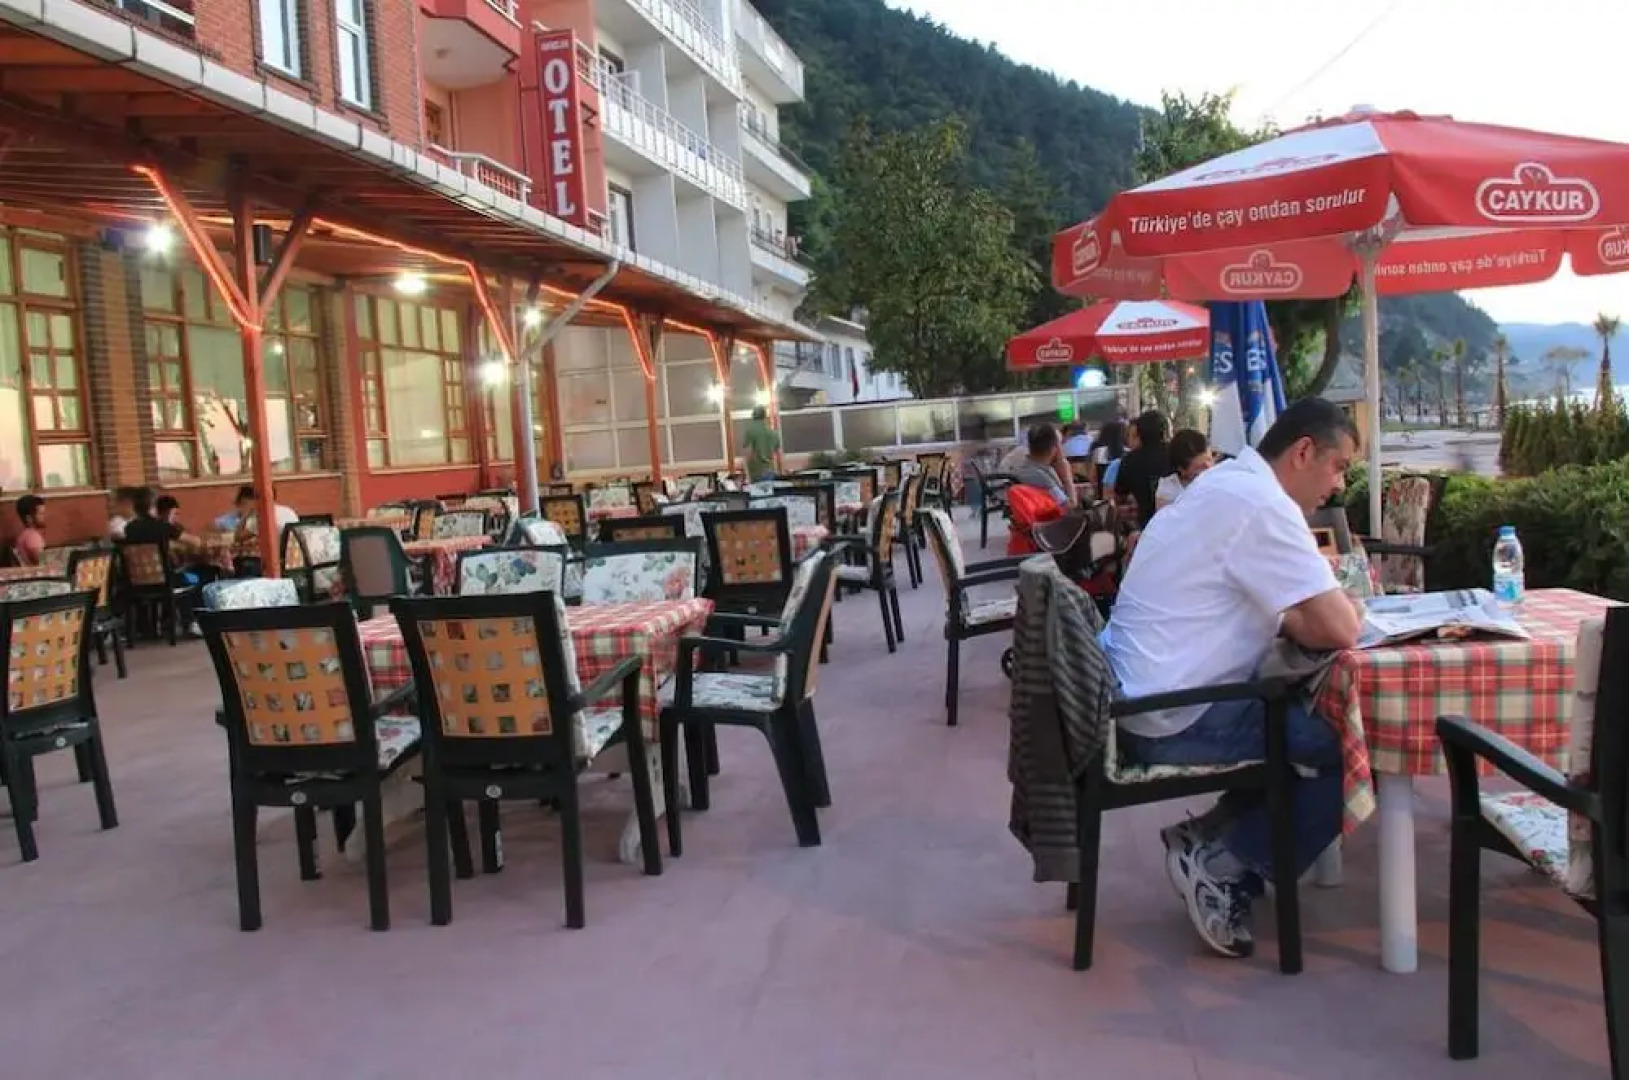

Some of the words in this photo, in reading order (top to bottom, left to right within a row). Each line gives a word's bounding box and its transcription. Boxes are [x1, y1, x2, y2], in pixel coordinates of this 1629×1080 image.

[543, 58, 576, 216] OTEL
[1129, 210, 1211, 235] Türkiye'de
[1216, 208, 1244, 230] çay
[1249, 199, 1301, 221] ondan
[1305, 188, 1367, 213] sorulur
